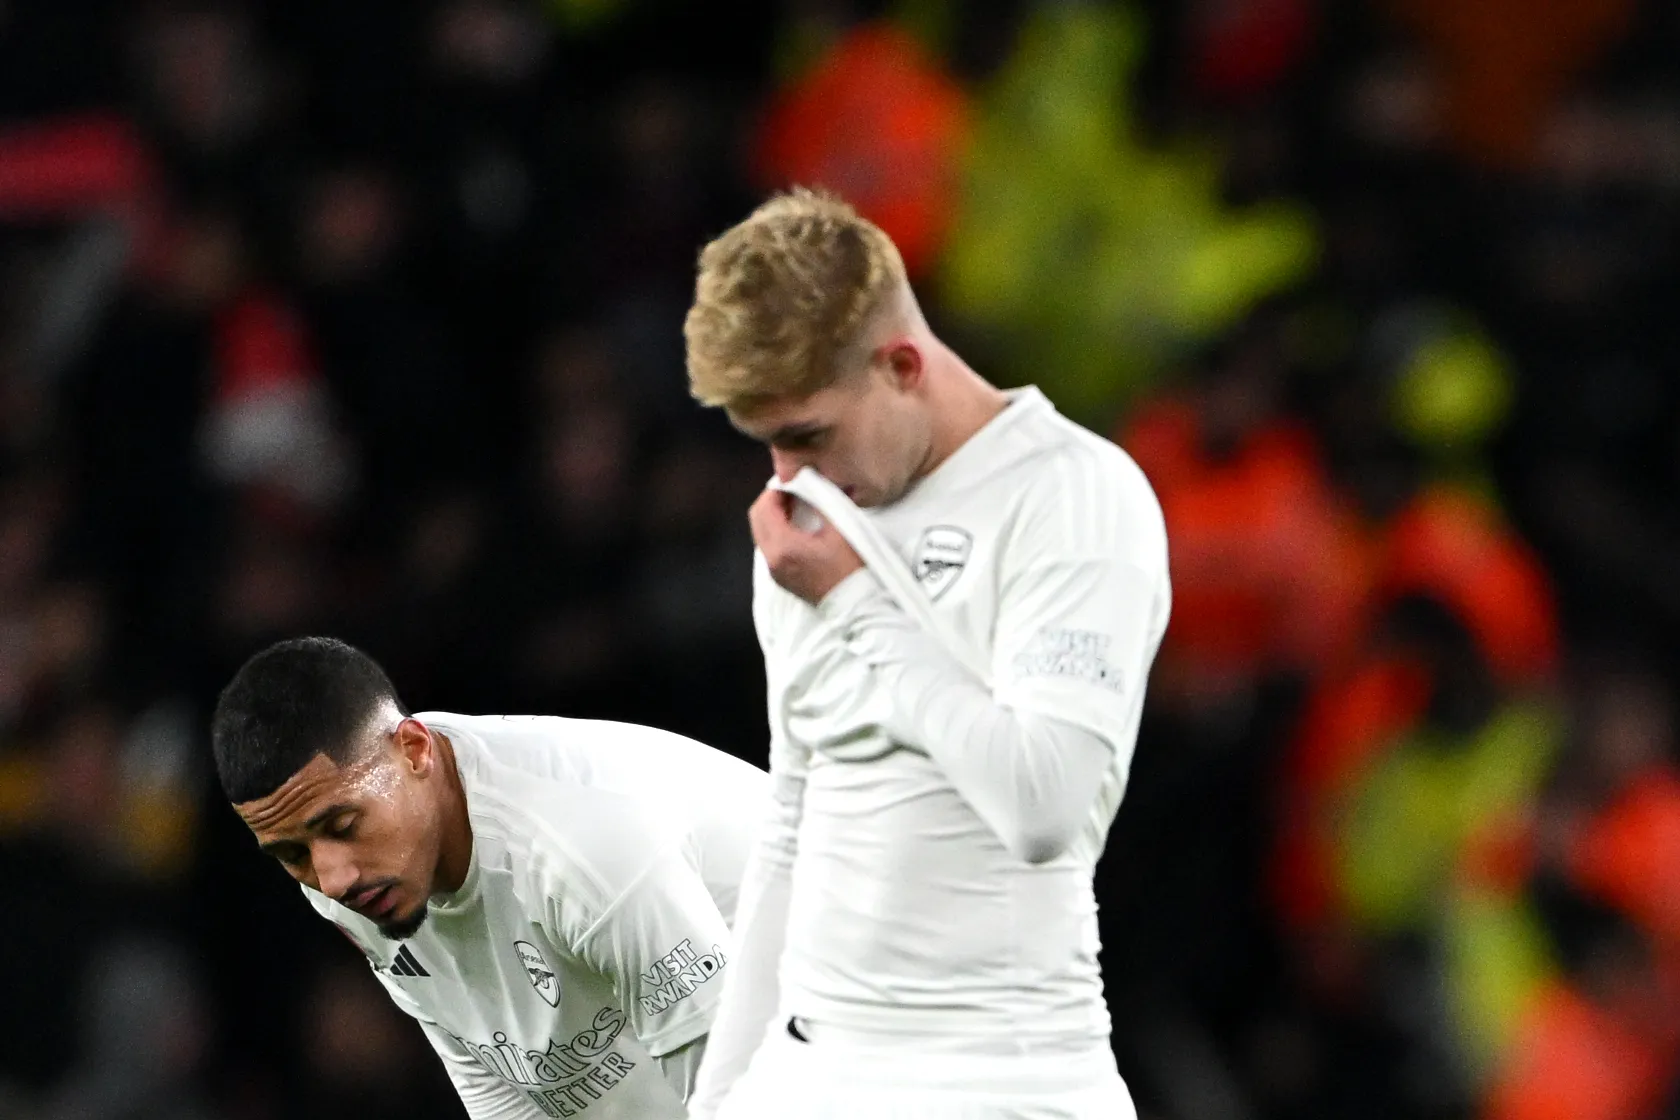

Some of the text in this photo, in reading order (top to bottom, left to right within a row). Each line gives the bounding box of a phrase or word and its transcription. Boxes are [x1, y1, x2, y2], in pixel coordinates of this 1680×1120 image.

[637, 944, 728, 1016] RWANDA
[640, 938, 697, 987] VISIT
[527, 1051, 637, 1119] BETTER
